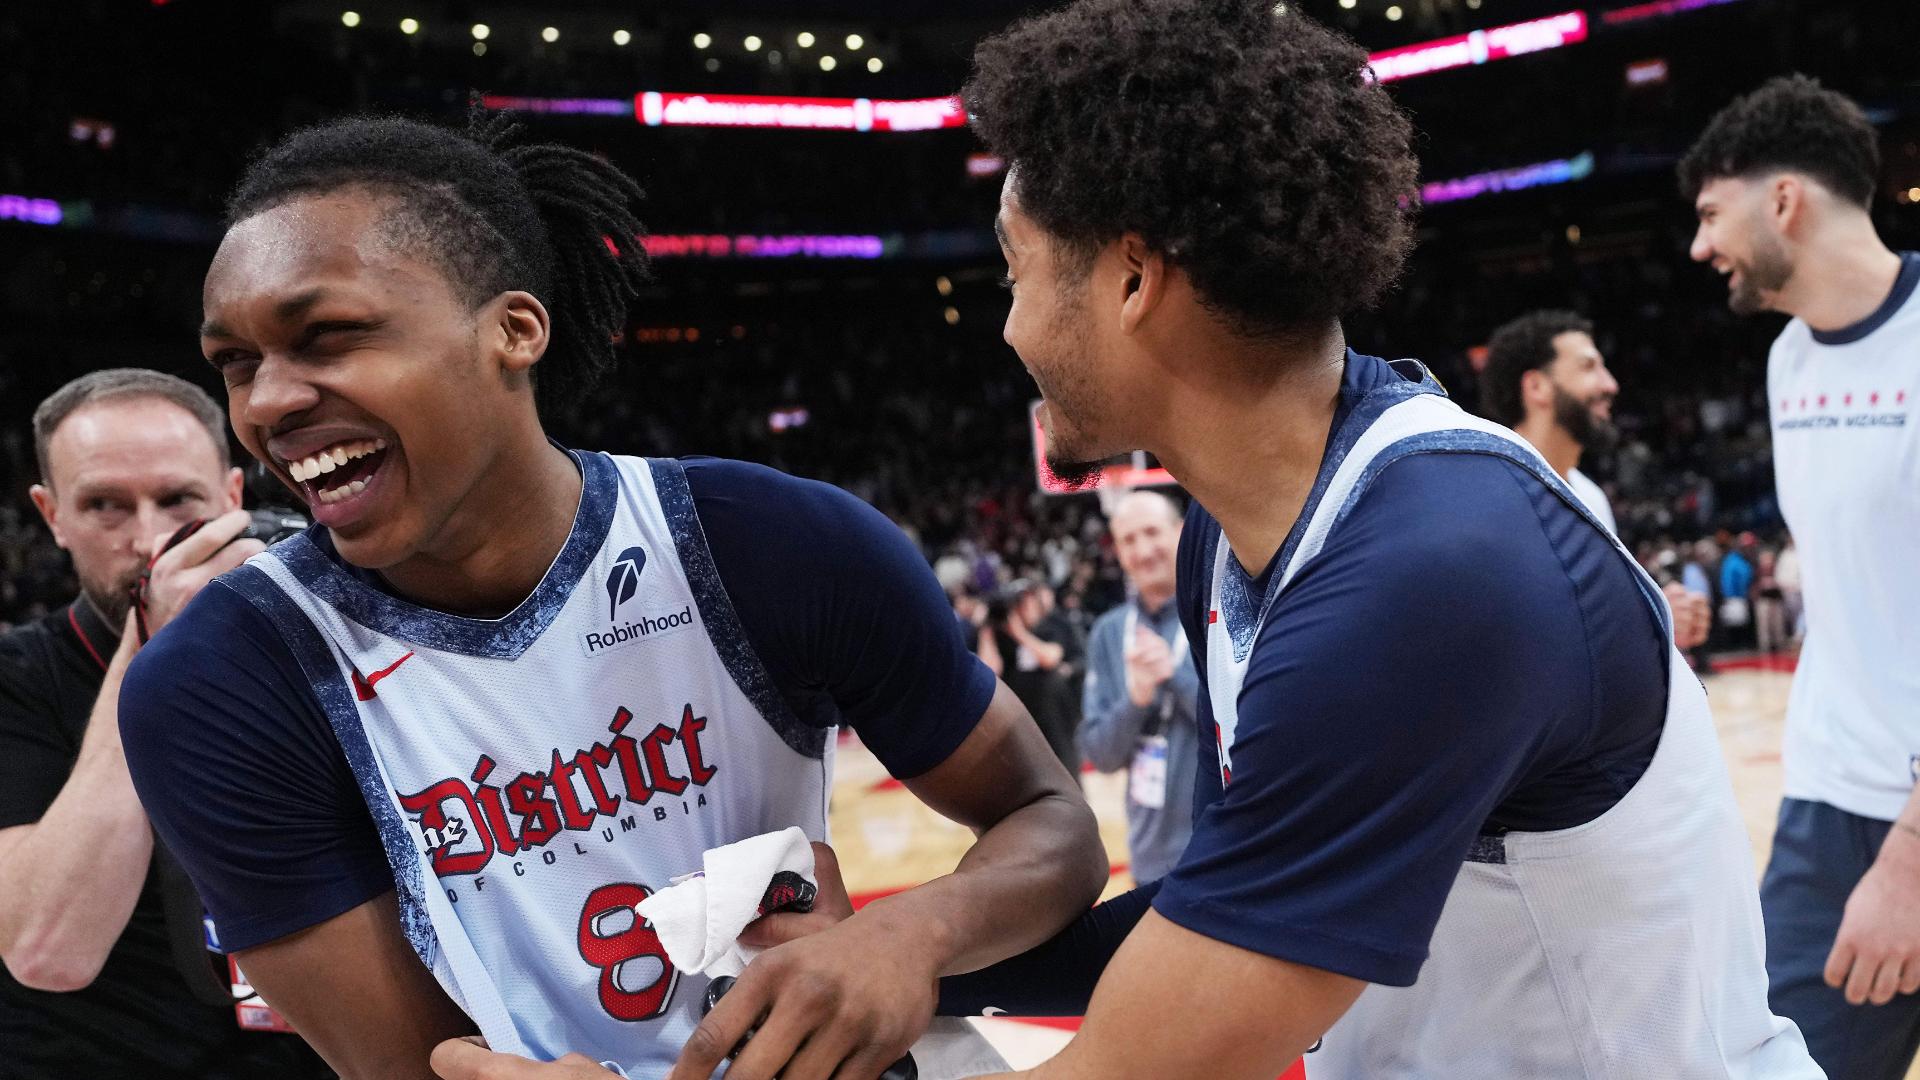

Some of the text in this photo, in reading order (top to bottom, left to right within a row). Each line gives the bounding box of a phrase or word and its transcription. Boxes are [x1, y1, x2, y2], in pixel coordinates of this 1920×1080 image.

[586, 606, 693, 652] Robinhood
[395, 703, 718, 878] District
[408, 817, 467, 856] he
[447, 793, 708, 903] OF COLUMBIA
[577, 882, 680, 1022] 8
